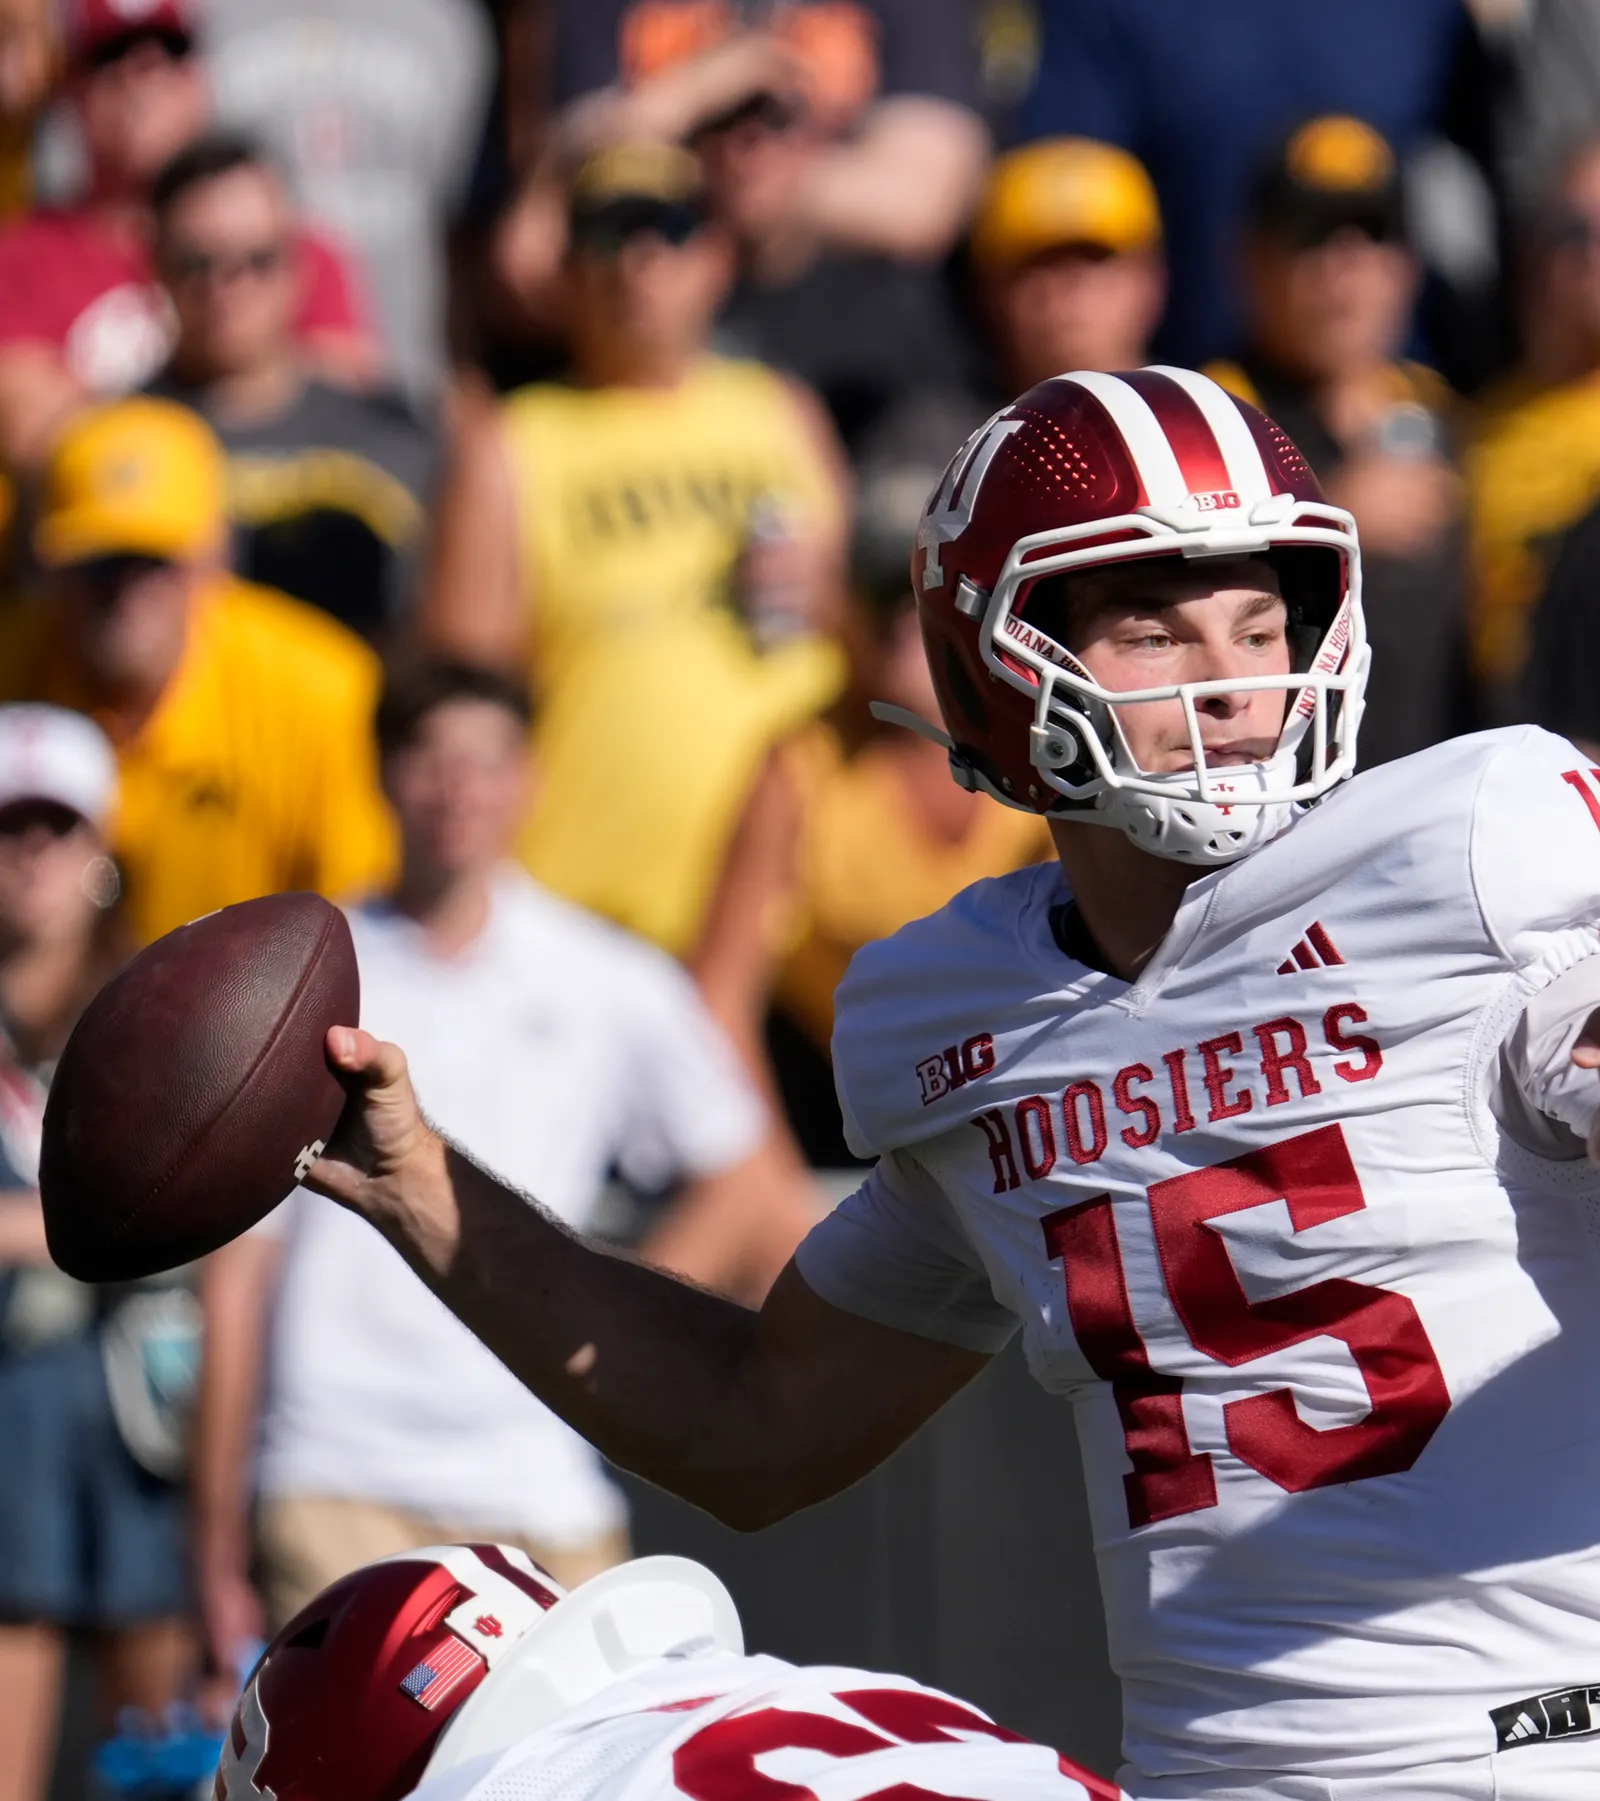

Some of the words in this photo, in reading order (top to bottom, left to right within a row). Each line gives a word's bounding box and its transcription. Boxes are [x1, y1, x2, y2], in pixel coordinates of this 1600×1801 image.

[969, 1002, 1384, 1195] HOOSIERS
[1040, 1123, 1452, 1529] 15
[1566, 1710, 1575, 1727] L
